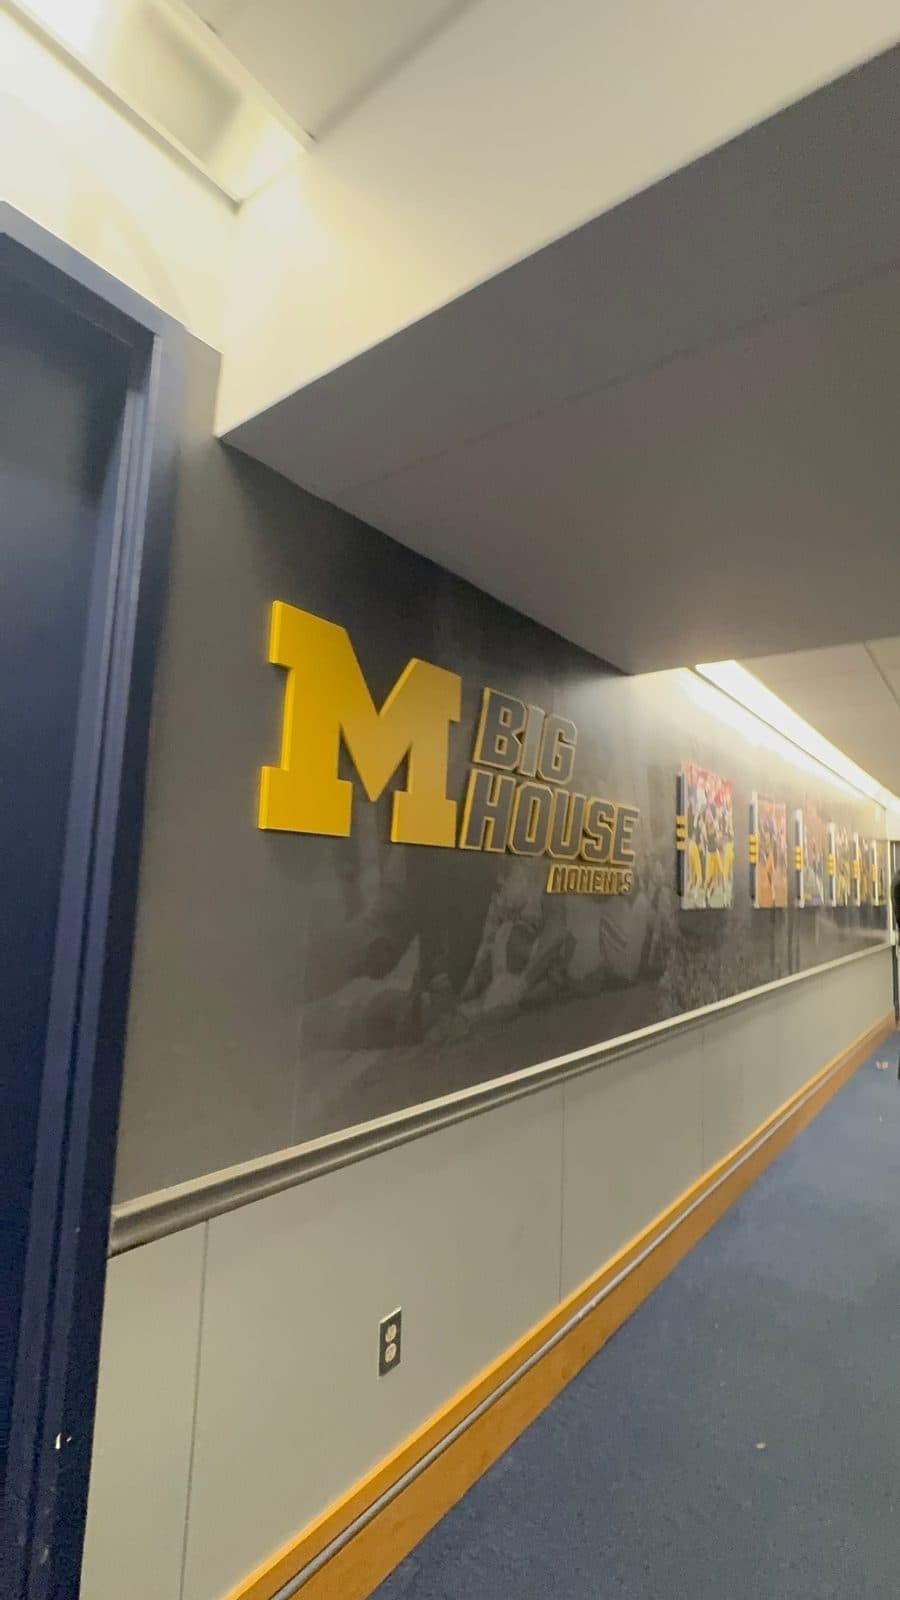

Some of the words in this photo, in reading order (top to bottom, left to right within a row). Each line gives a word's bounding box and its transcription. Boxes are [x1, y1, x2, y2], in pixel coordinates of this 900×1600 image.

[258, 600, 462, 848] M
[473, 687, 578, 784] BIG
[459, 769, 640, 864] HOUSE
[546, 864, 633, 894] MOMENTS
